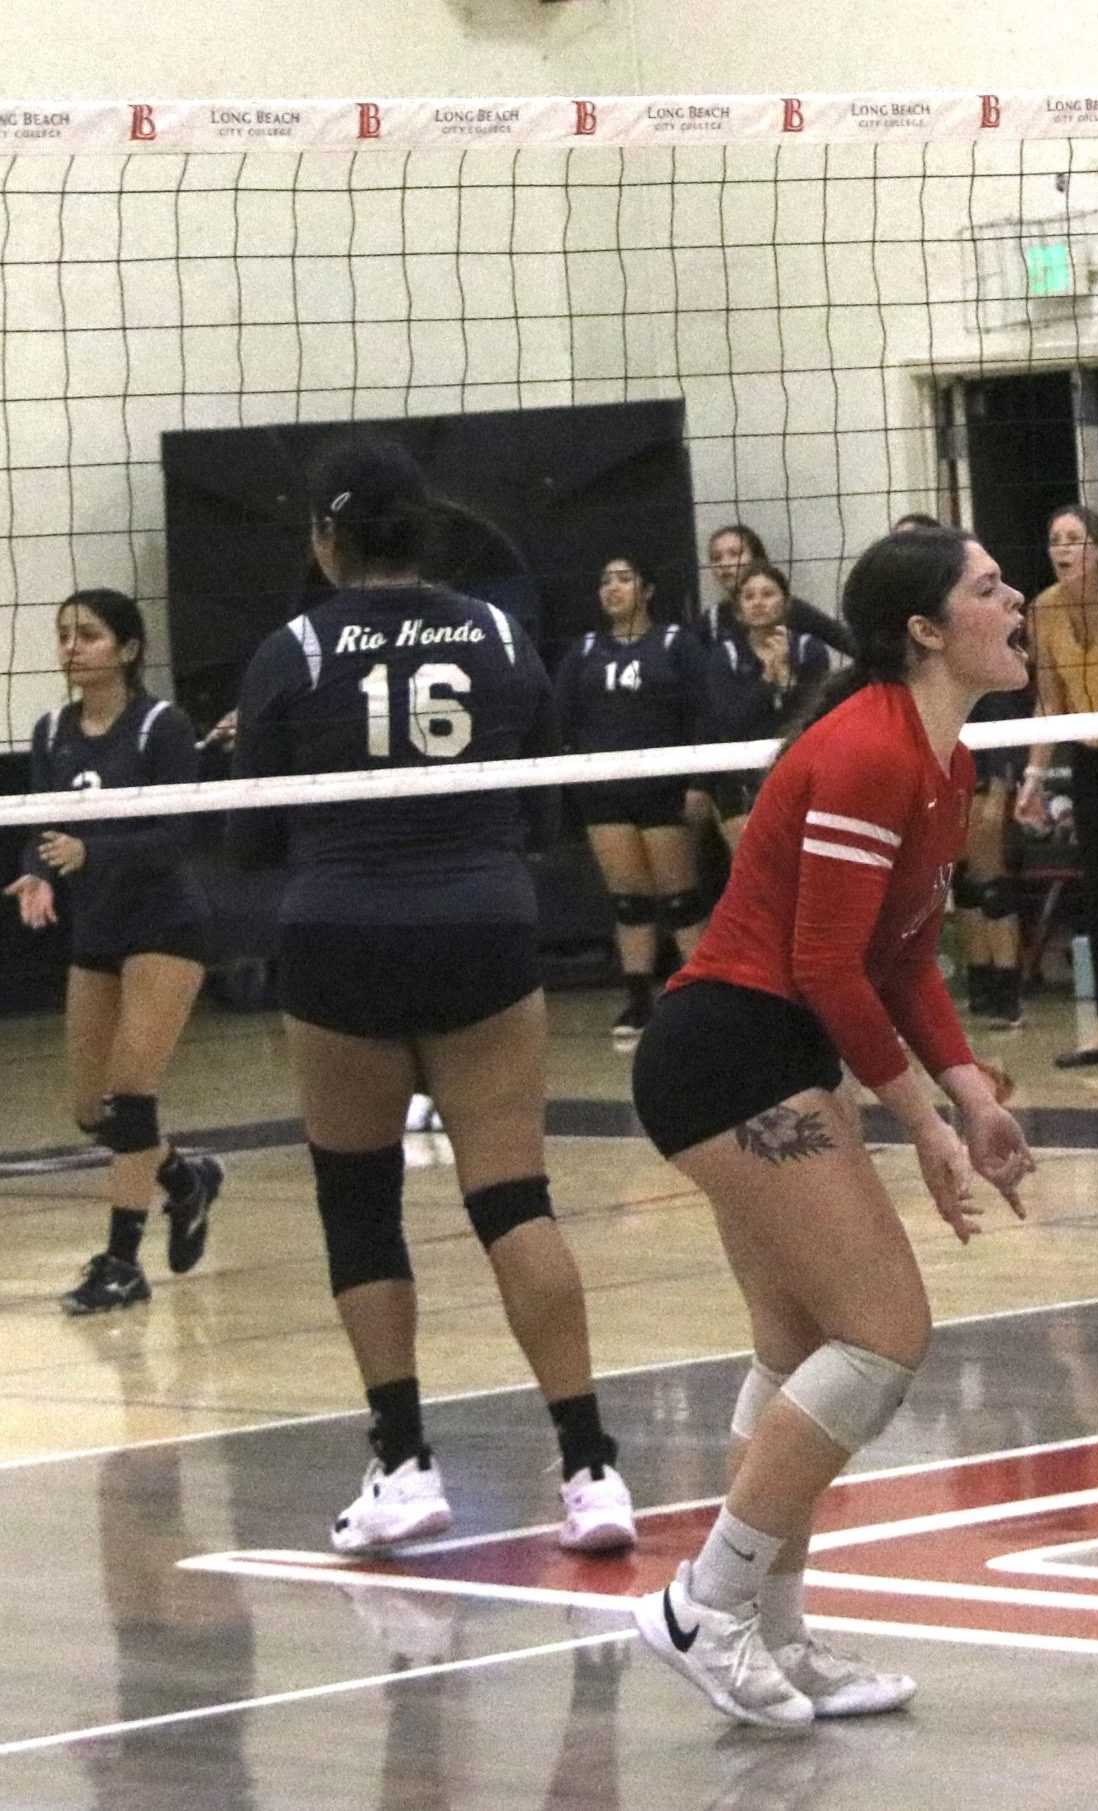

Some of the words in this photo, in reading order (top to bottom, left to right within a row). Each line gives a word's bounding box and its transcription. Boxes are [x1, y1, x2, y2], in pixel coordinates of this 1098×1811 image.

[435, 109, 474, 122] LONG
[477, 109, 519, 122] BEACH
[648, 105, 684, 119] LONG
[689, 106, 730, 118] BEACH
[851, 104, 888, 116] LONG
[891, 103, 931, 116] BEACH
[211, 110, 252, 124] LONG
[256, 110, 300, 124] BEACH
[335, 624, 388, 653] Rio
[395, 618, 486, 647] Hondo
[605, 660, 642, 691] 14
[358, 663, 472, 758] 16
